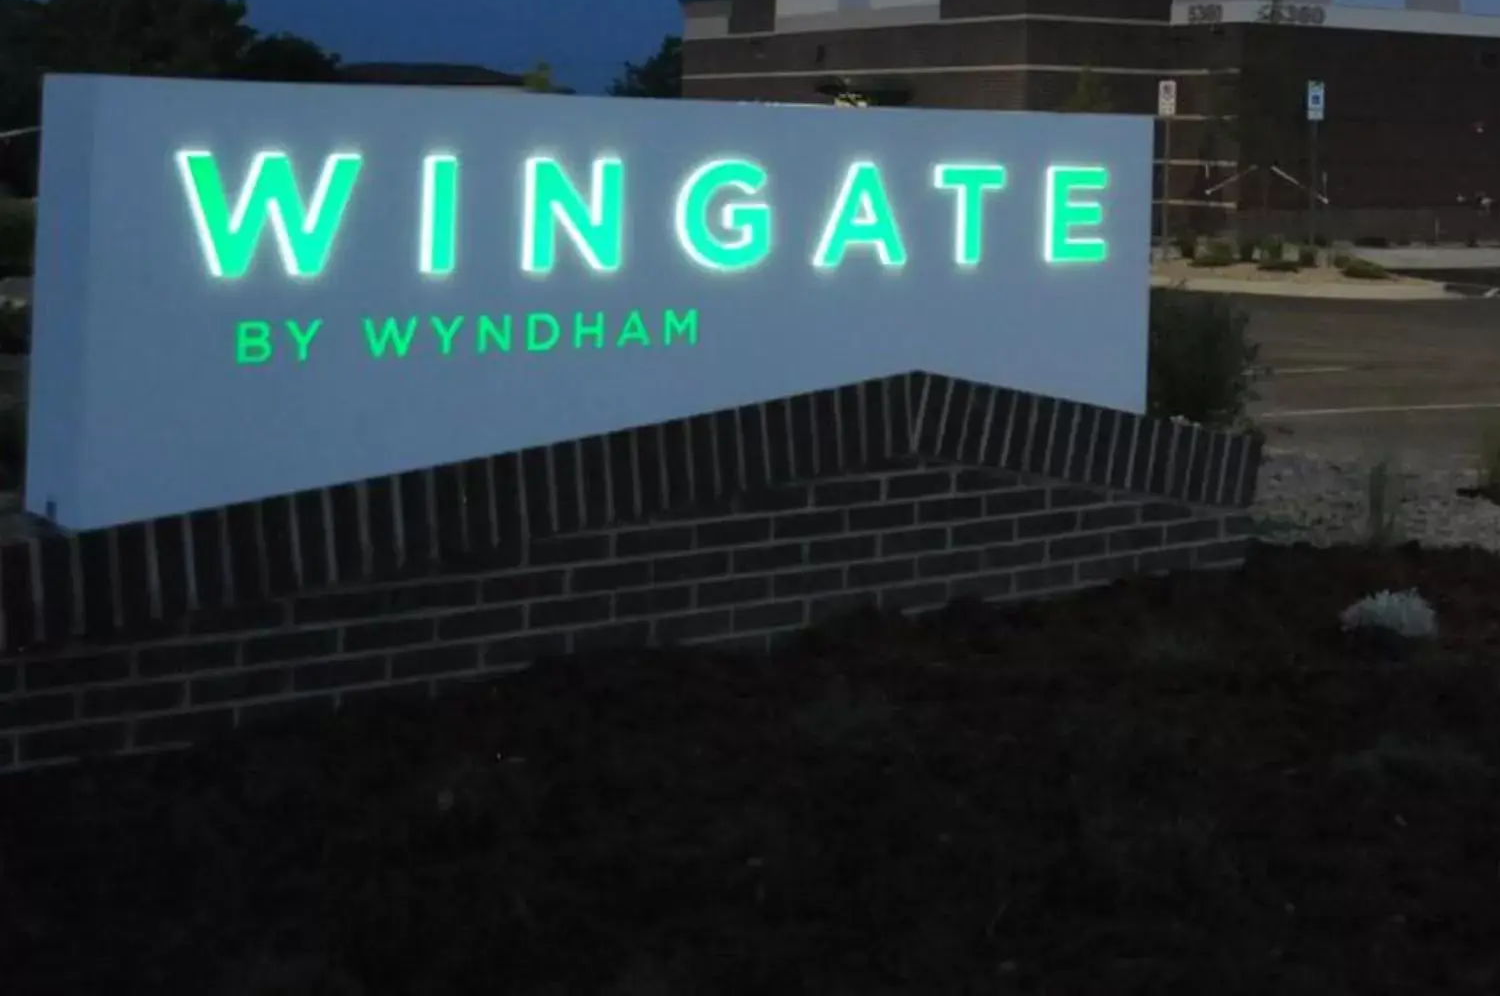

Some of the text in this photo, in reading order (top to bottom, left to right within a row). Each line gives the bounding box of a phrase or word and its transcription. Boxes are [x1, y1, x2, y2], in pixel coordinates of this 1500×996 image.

[175, 149, 1109, 277] WINGATE
[235, 308, 699, 364] BY WYNDHAM
